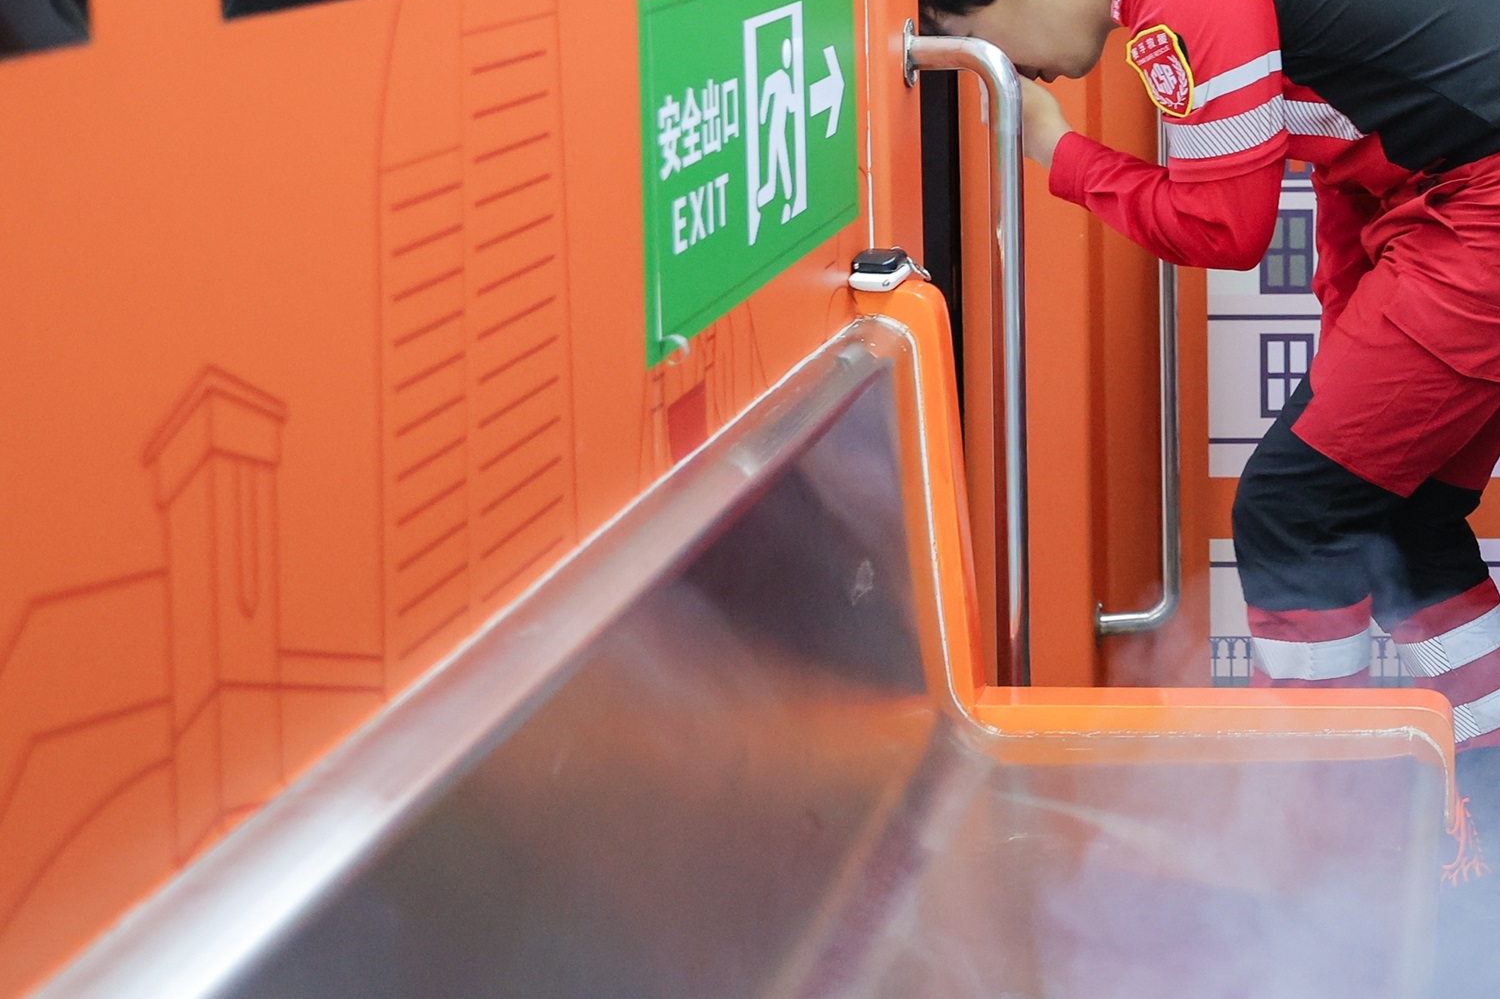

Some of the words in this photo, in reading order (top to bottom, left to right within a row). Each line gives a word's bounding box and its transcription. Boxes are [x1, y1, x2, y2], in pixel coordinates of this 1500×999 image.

[656, 77, 741, 182] 安全出口
[671, 172, 730, 256] EXIT
